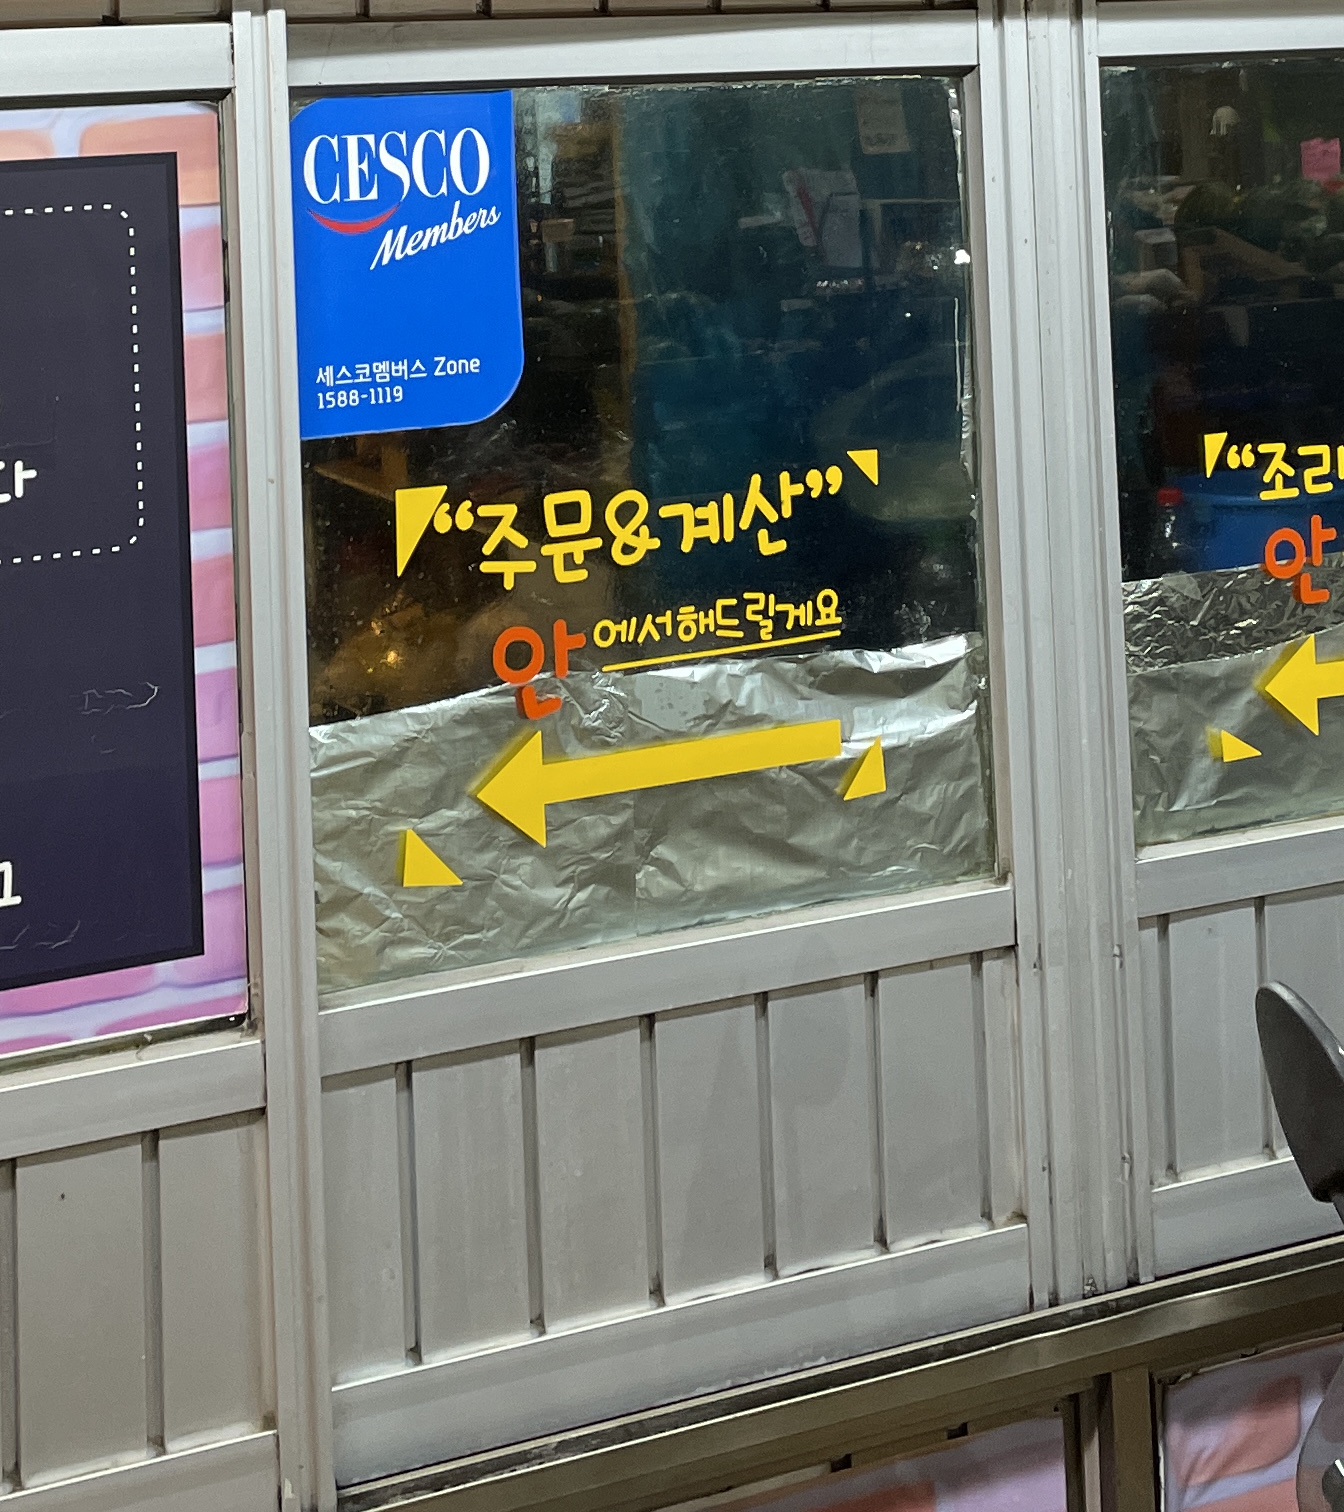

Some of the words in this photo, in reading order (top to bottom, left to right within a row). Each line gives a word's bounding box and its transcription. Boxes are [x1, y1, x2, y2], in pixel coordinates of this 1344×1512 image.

[303, 127, 491, 205] CESCO
[369, 200, 502, 271] Members
[315, 358, 428, 388] 세스코멤버스
[433, 355, 481, 377] Zone
[317, 385, 404, 410] 1588-1119
